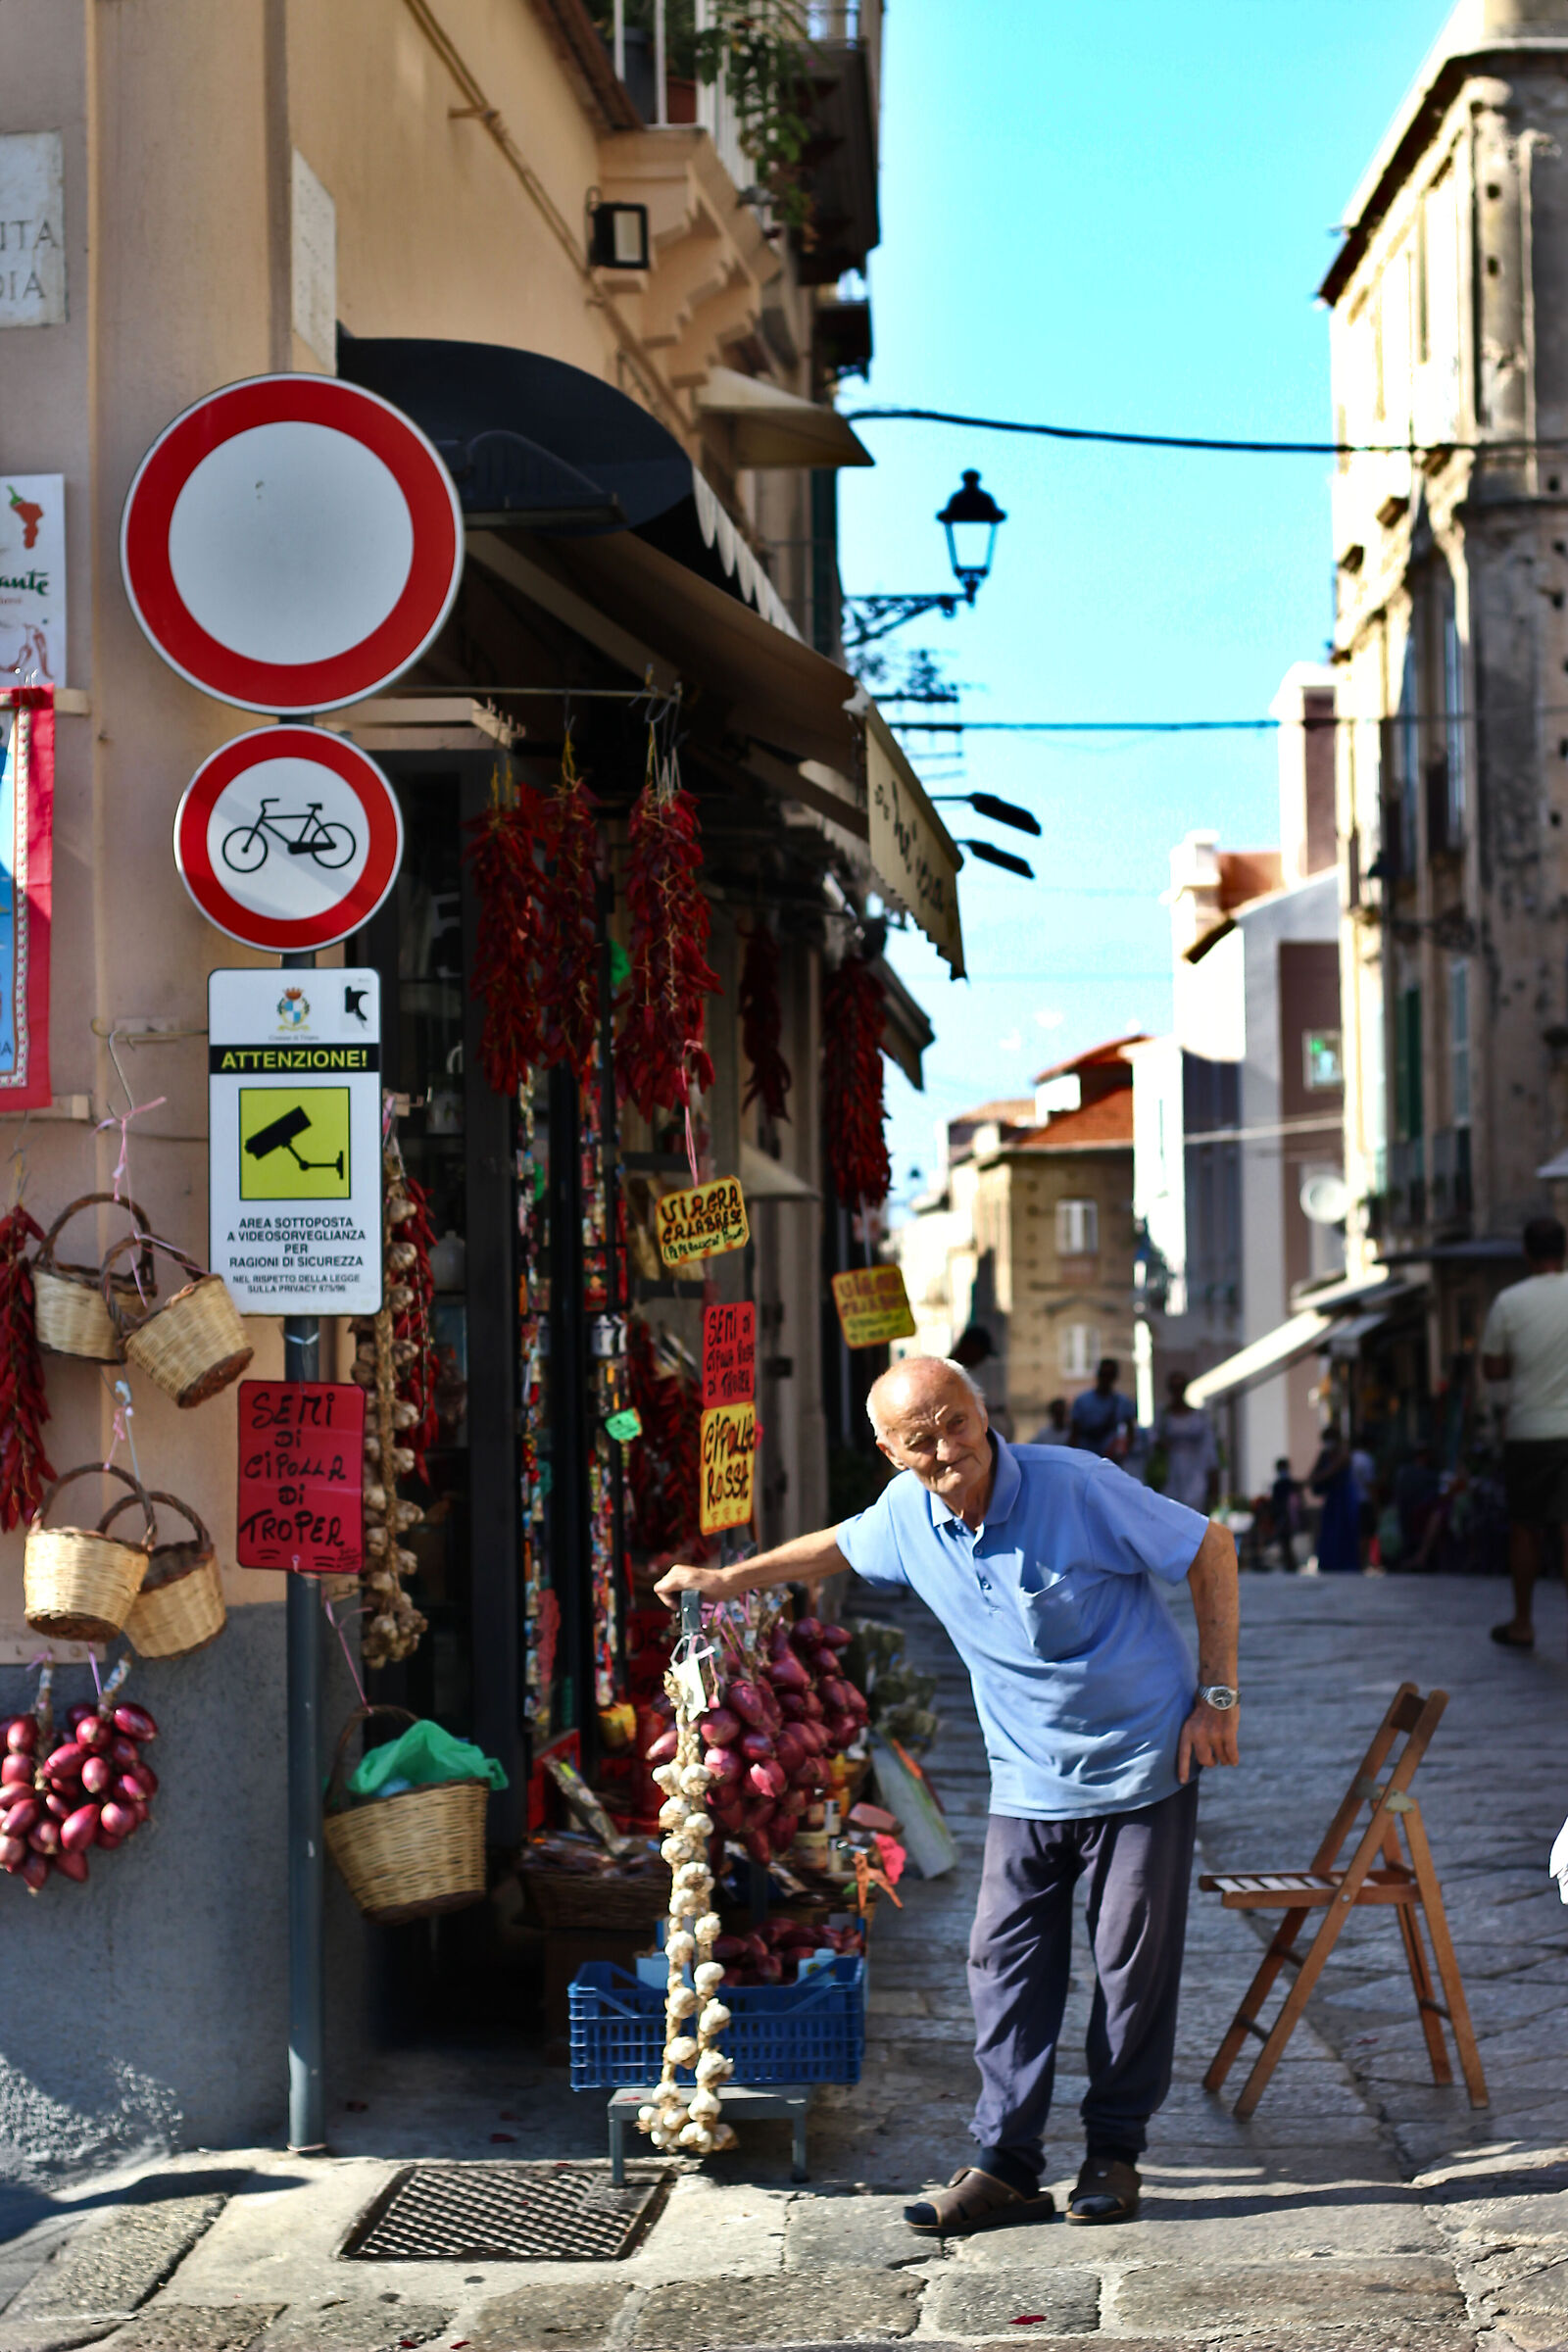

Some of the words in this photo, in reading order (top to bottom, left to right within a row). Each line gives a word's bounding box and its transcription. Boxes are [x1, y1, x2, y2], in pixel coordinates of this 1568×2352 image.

[0, 270, 47, 300] IA
[220, 1050, 368, 1069] ATTENZIONE!
[239, 1217, 271, 1229] AREA
[274, 1216, 354, 1228] SOTTOPOSTA
[226, 1231, 235, 1242] A
[238, 1230, 367, 1242] VIDEOSORVEGLIANZA
[284, 1244, 309, 1254] PER
[229, 1256, 279, 1268] RAGIONI
[282, 1256, 294, 1267] DI
[297, 1255, 364, 1267] SICUREZZA
[232, 1275, 250, 1284] NEL
[252, 1274, 296, 1284] RISPETTO
[298, 1274, 327, 1283] DELLA
[329, 1273, 361, 1283] LEGGE
[248, 1284, 276, 1294] SULLA
[278, 1284, 317, 1293] PRIVACY
